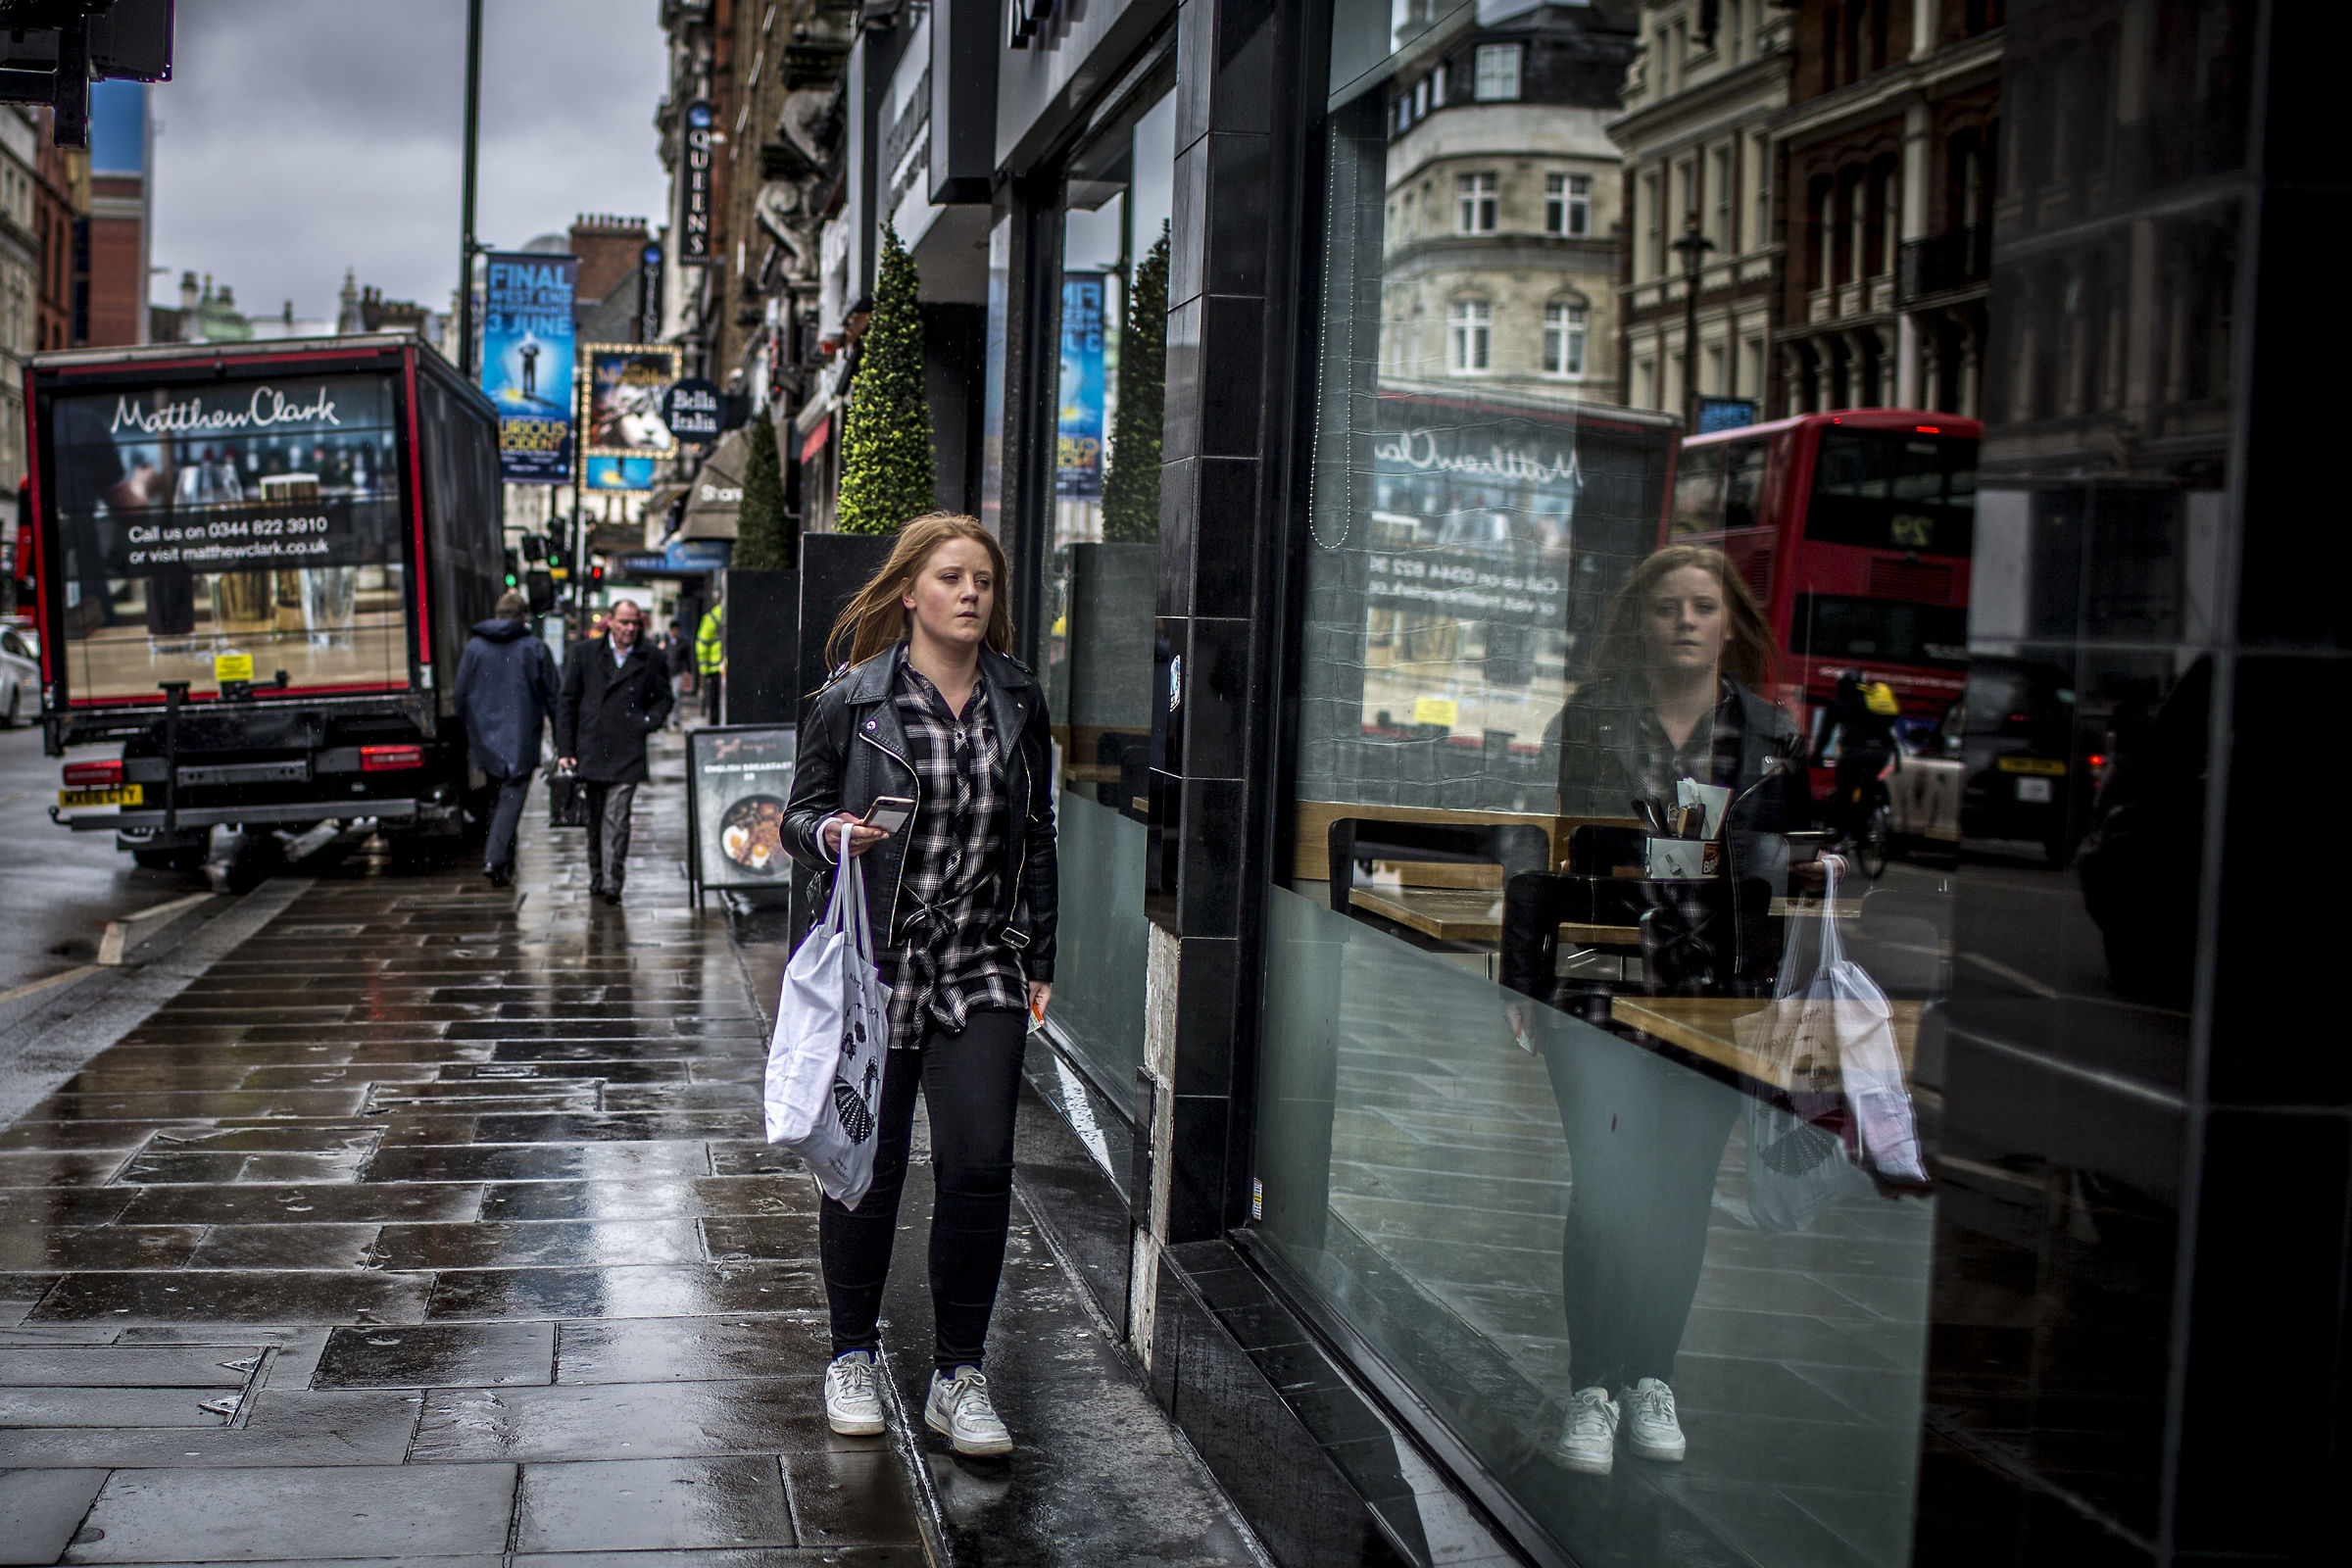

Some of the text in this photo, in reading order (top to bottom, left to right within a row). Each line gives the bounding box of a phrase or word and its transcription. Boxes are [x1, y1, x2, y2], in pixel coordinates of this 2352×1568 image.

[490, 263, 572, 290] FINAL
[489, 290, 572, 305] WEST END
[488, 315, 572, 335] 3 JUNE
[671, 389, 716, 410] Bella
[500, 419, 567, 438] URIOUS
[671, 411, 716, 432] Italia
[128, 516, 328, 543] Call us on 0344 822 3910
[129, 538, 329, 564] or visit matthewclark.co.uk
